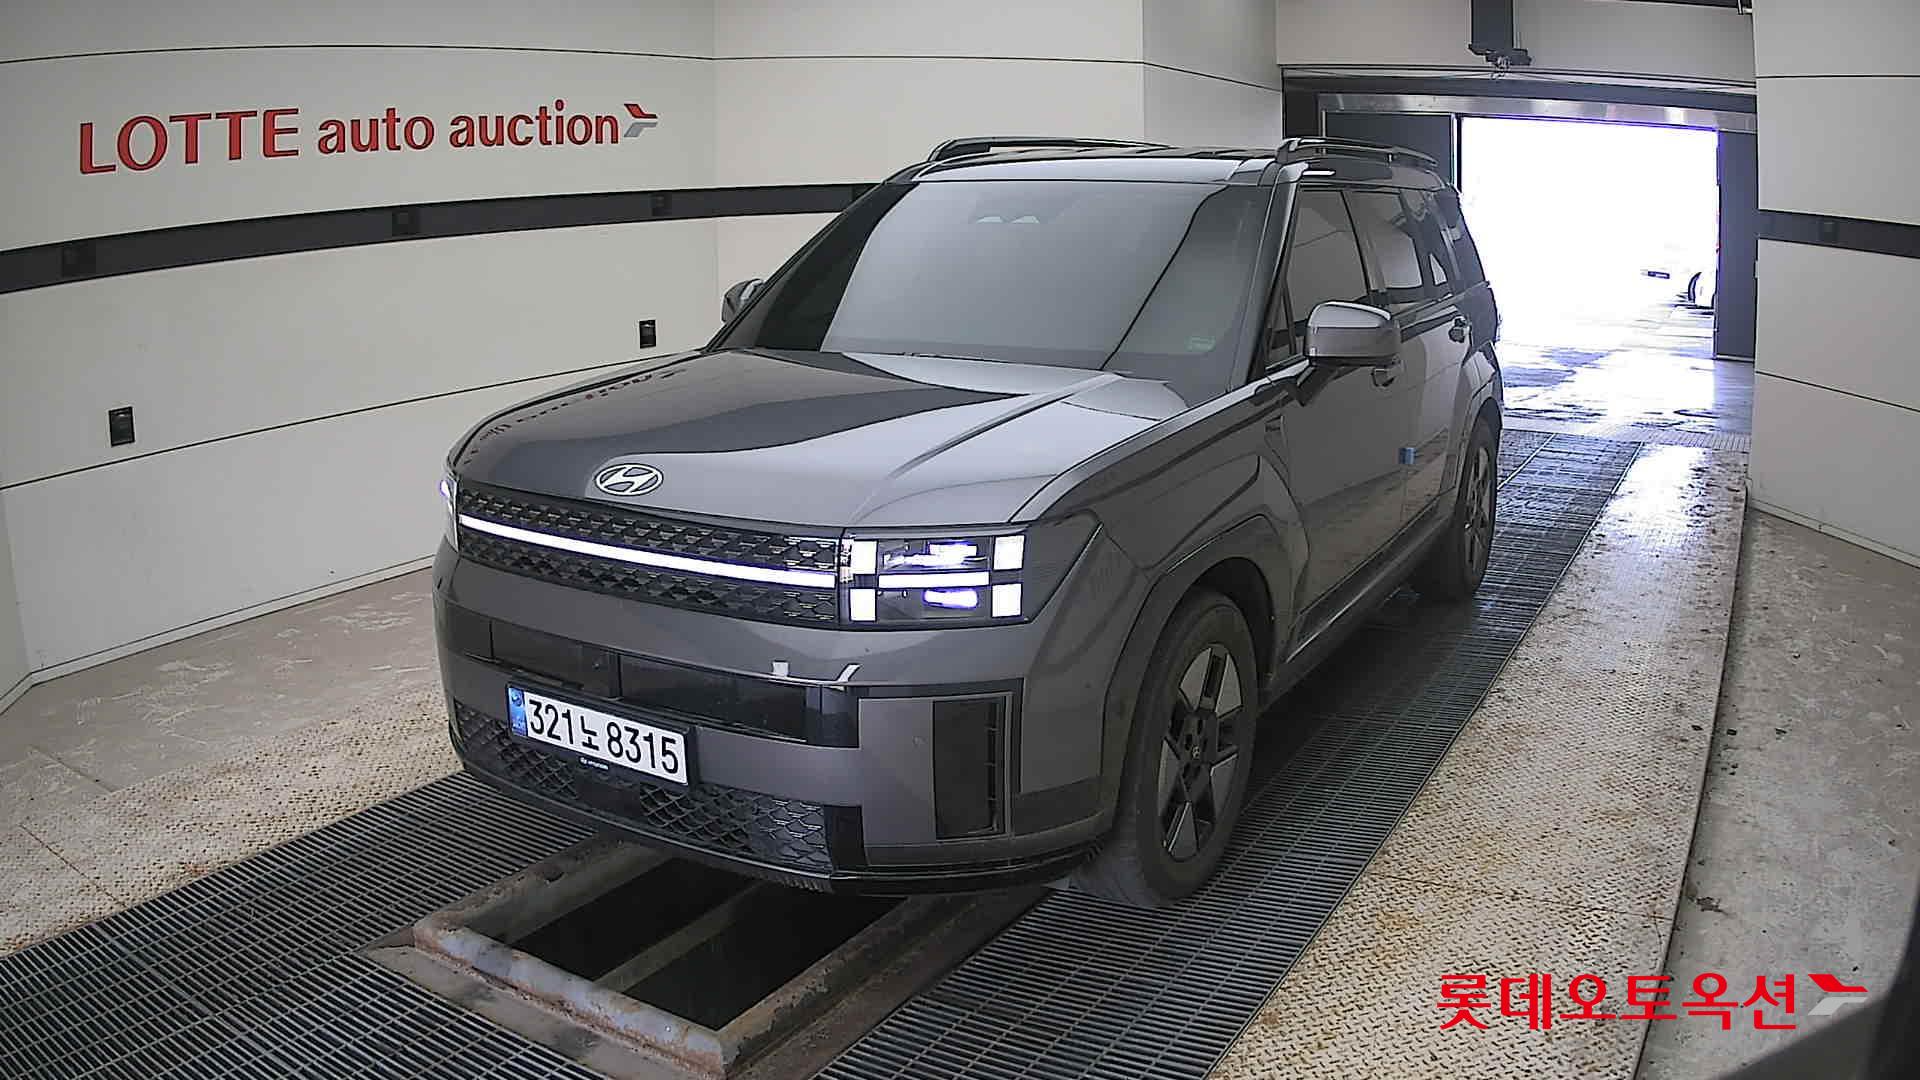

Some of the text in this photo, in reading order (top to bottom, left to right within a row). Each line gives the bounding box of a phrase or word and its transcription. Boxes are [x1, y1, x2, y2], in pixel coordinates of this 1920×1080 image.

[80, 99, 619, 175] LOTTE auto auction
[529, 699, 678, 774] 321노 8315
